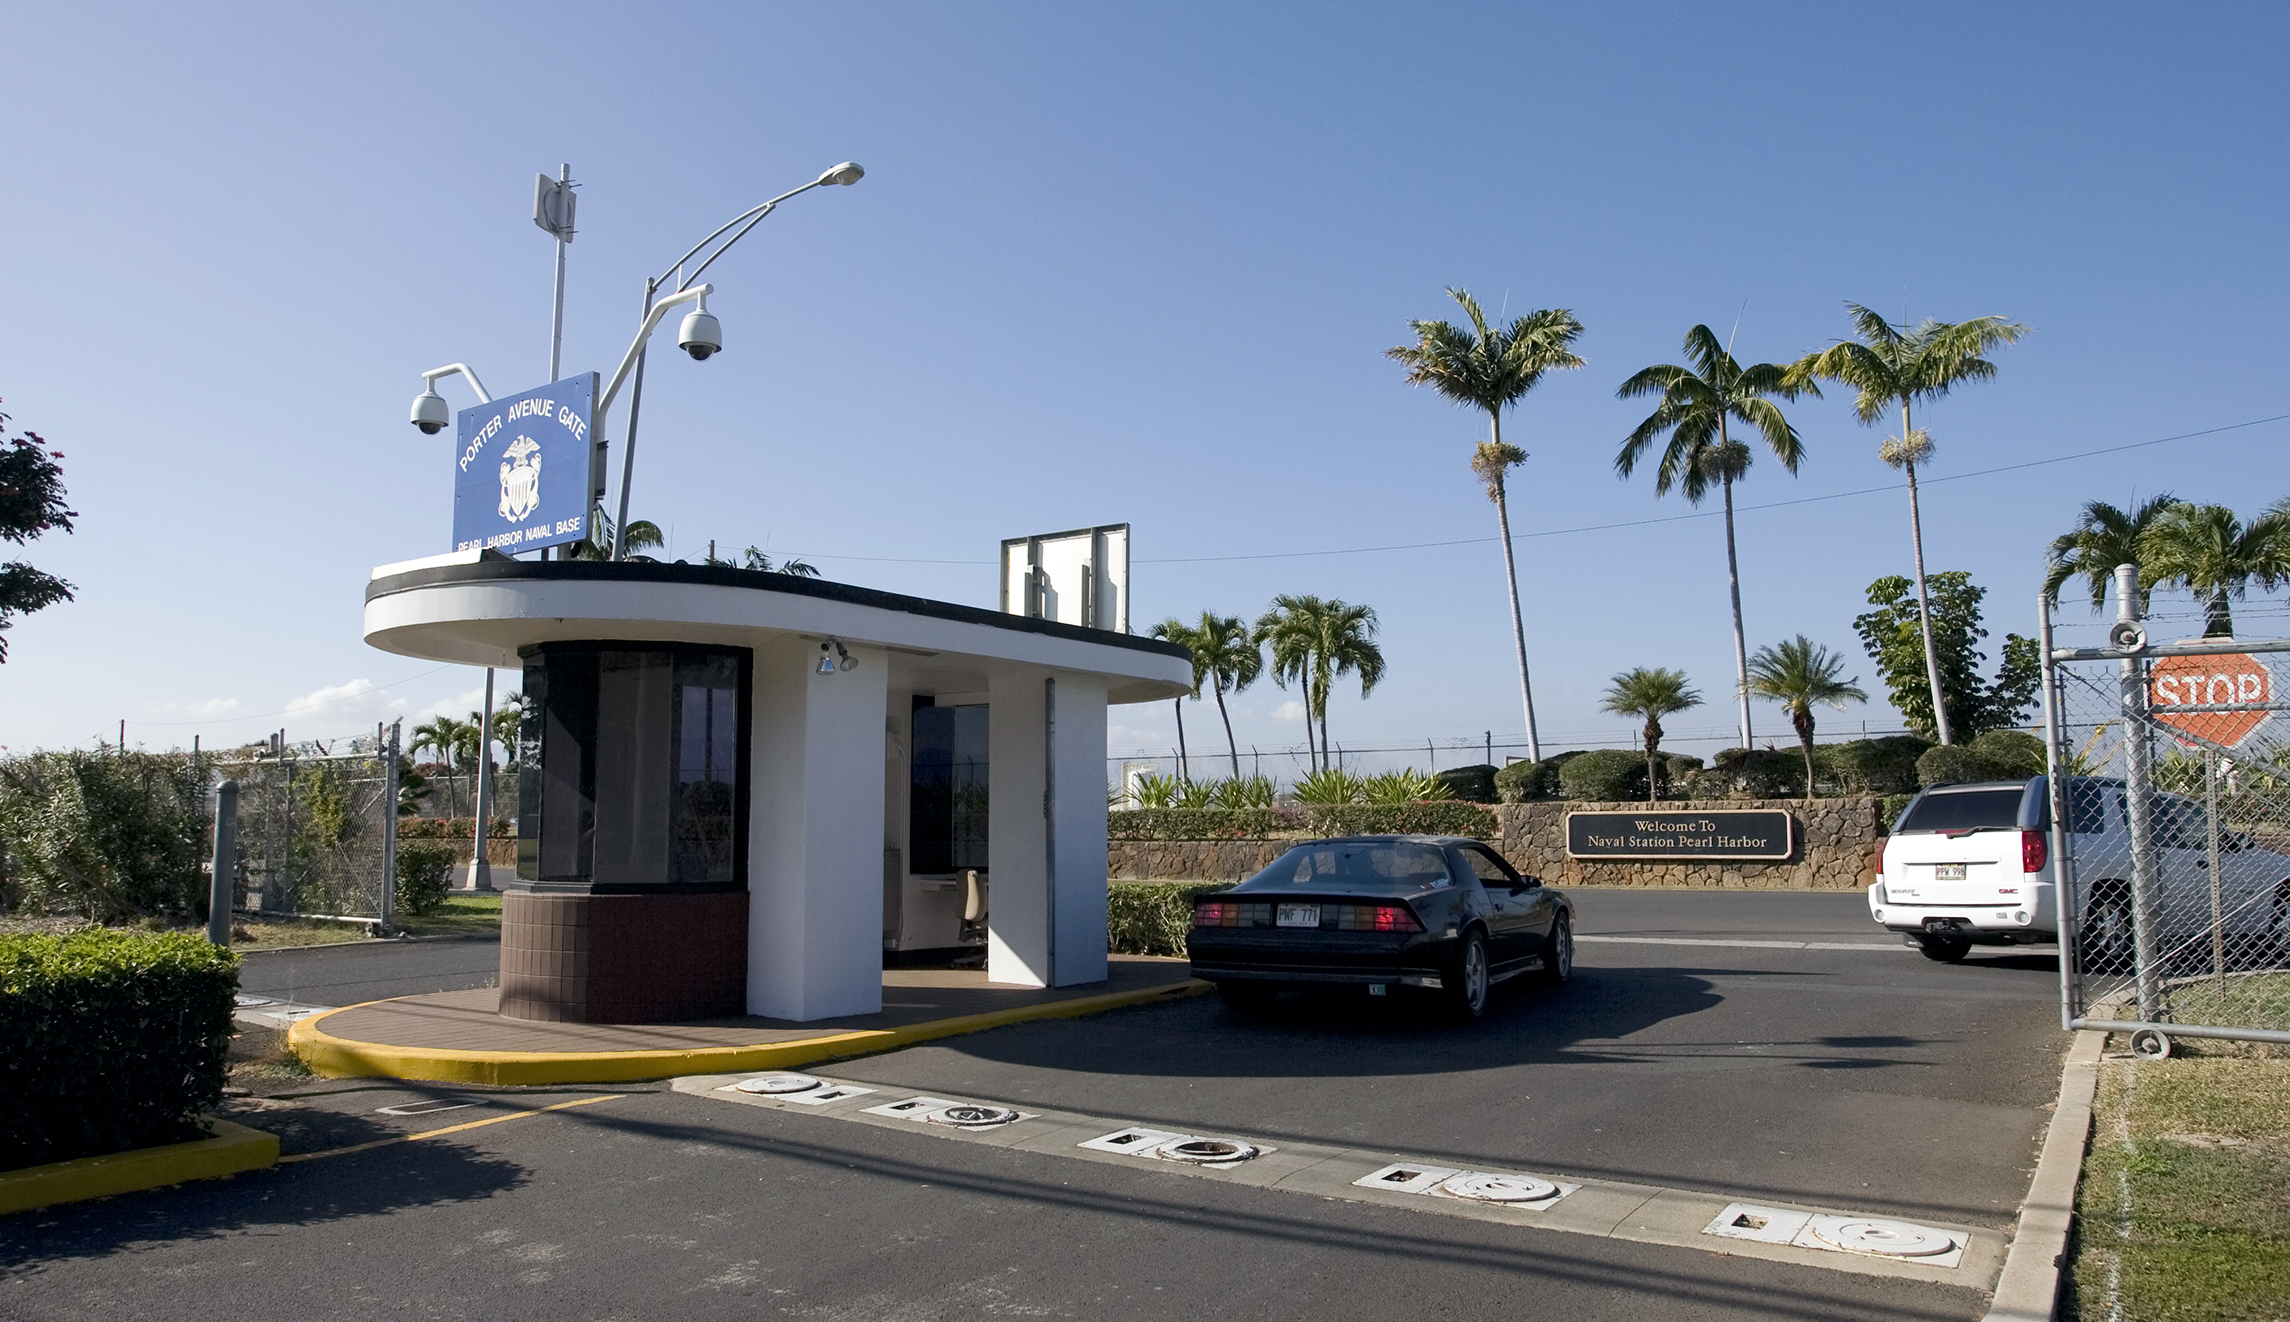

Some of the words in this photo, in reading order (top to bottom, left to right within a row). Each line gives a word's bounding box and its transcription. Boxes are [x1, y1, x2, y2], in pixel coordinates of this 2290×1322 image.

[459, 414, 502, 472] PORTER
[508, 398, 554, 423] AVENUE
[558, 406, 586, 441] GATE
[487, 530, 523, 549] HARBOR
[525, 524, 552, 542] NAVAL
[556, 517, 581, 535] BASE
[2156, 673, 2262, 715] STOP
[1634, 820, 1697, 832] Welcome
[1699, 819, 1716, 832] To
[1588, 835, 1625, 848] Naval
[1628, 835, 1675, 848] Station
[1678, 835, 1713, 848] Pearl
[1717, 835, 1767, 848] Harbor
[1278, 908, 1297, 921] PWF
[1301, 908, 1318, 922] 771
